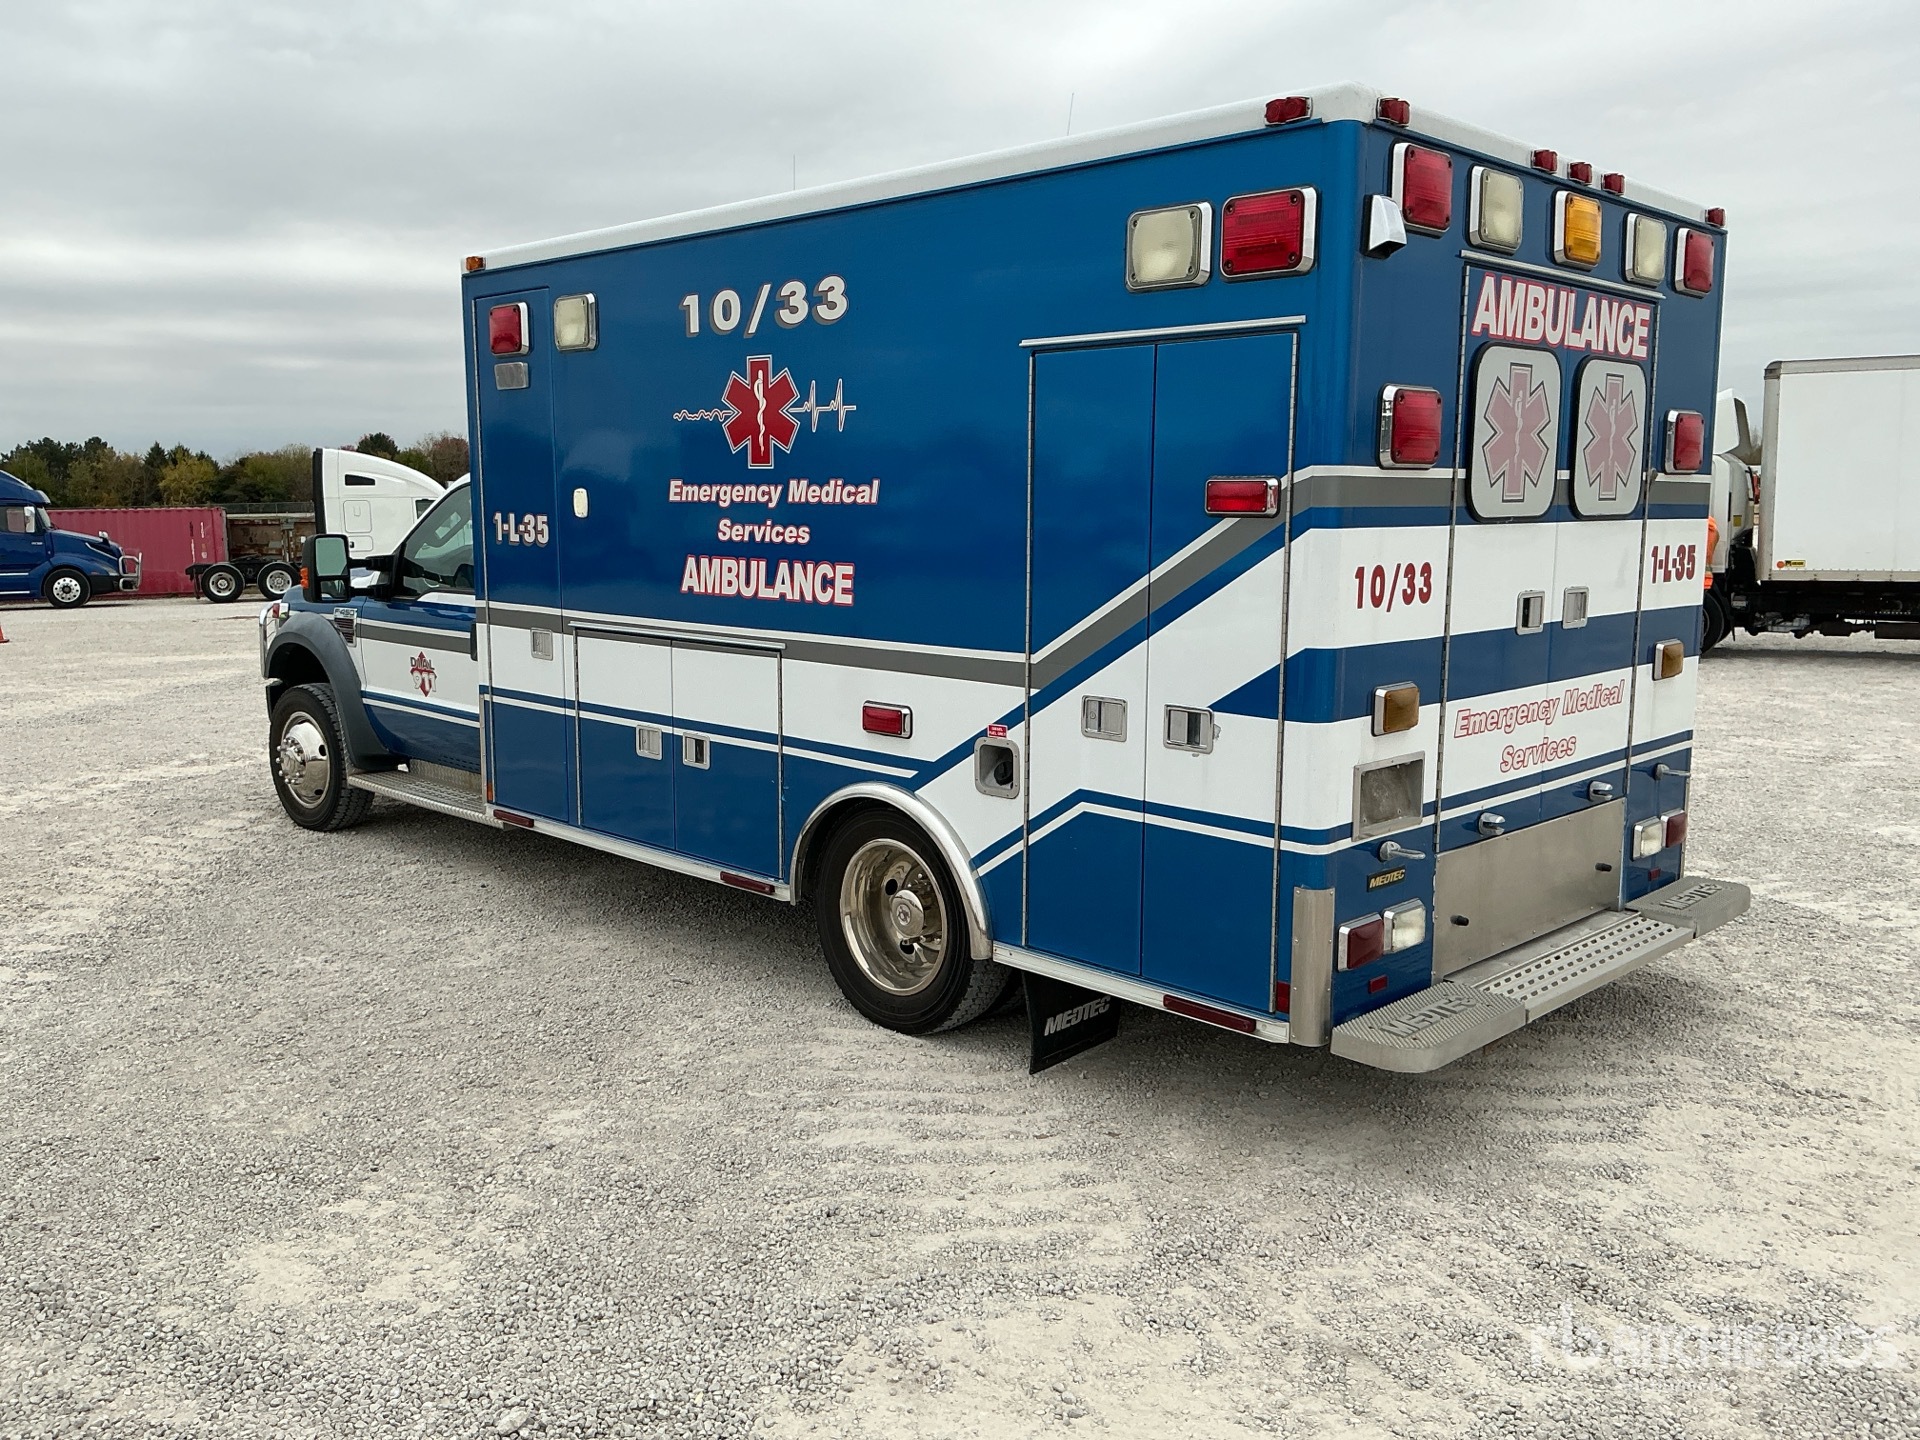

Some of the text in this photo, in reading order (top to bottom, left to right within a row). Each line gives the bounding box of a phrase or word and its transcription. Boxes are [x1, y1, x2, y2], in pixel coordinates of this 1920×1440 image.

[679, 274, 849, 337] 10/33
[1471, 272, 1652, 360] AMBULANCE
[668, 478, 880, 508] Emergency Medical
[493, 511, 549, 547] 1-L-35
[717, 518, 811, 545] Services
[680, 554, 856, 607] AMBULANCE
[1650, 544, 1697, 584] 1-L-35
[1354, 561, 1433, 613] 10/33
[410, 657, 435, 670] DIAL
[412, 670, 436, 693] 911
[1454, 679, 1625, 739] Emergency Medical
[1499, 735, 1577, 773] Services
[1369, 869, 1406, 889] MEDTEC
[1043, 995, 1111, 1037] MEDTEC
